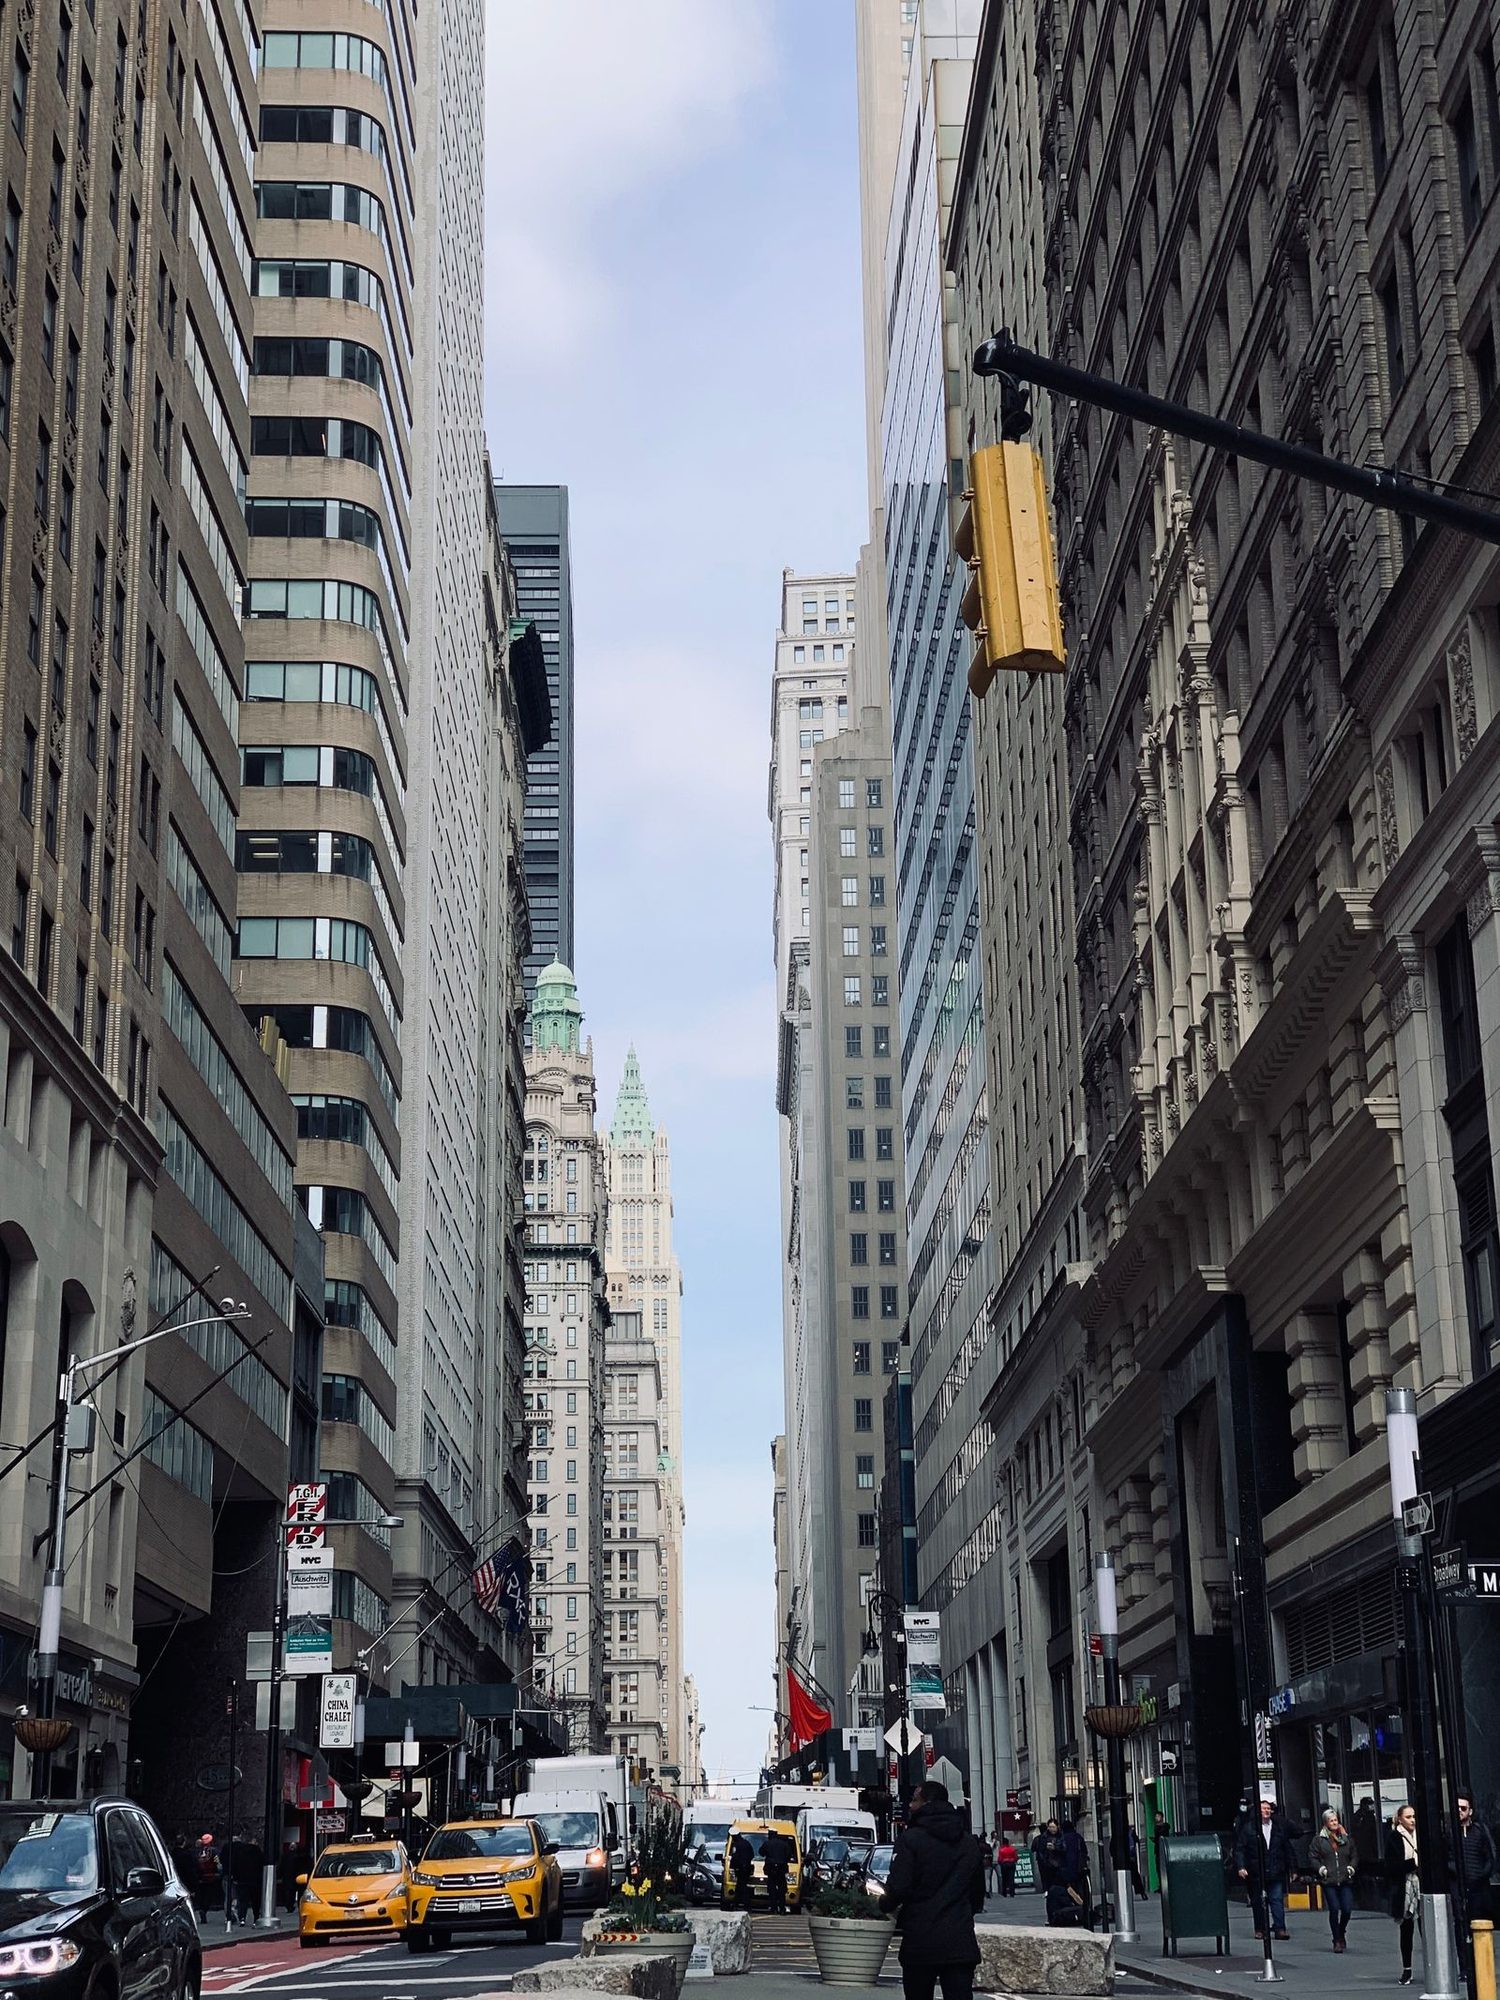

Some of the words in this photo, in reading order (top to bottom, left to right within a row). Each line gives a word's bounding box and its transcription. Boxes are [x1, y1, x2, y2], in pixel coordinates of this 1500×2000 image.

[295, 1488, 320, 1498] T.G.I.
[296, 1501, 319, 1549] FRID
[301, 1557, 321, 1565] NYC
[294, 1575, 328, 1583] Auschwitz
[328, 1700, 349, 1710] CHINA
[325, 1712, 352, 1722] CHALET
